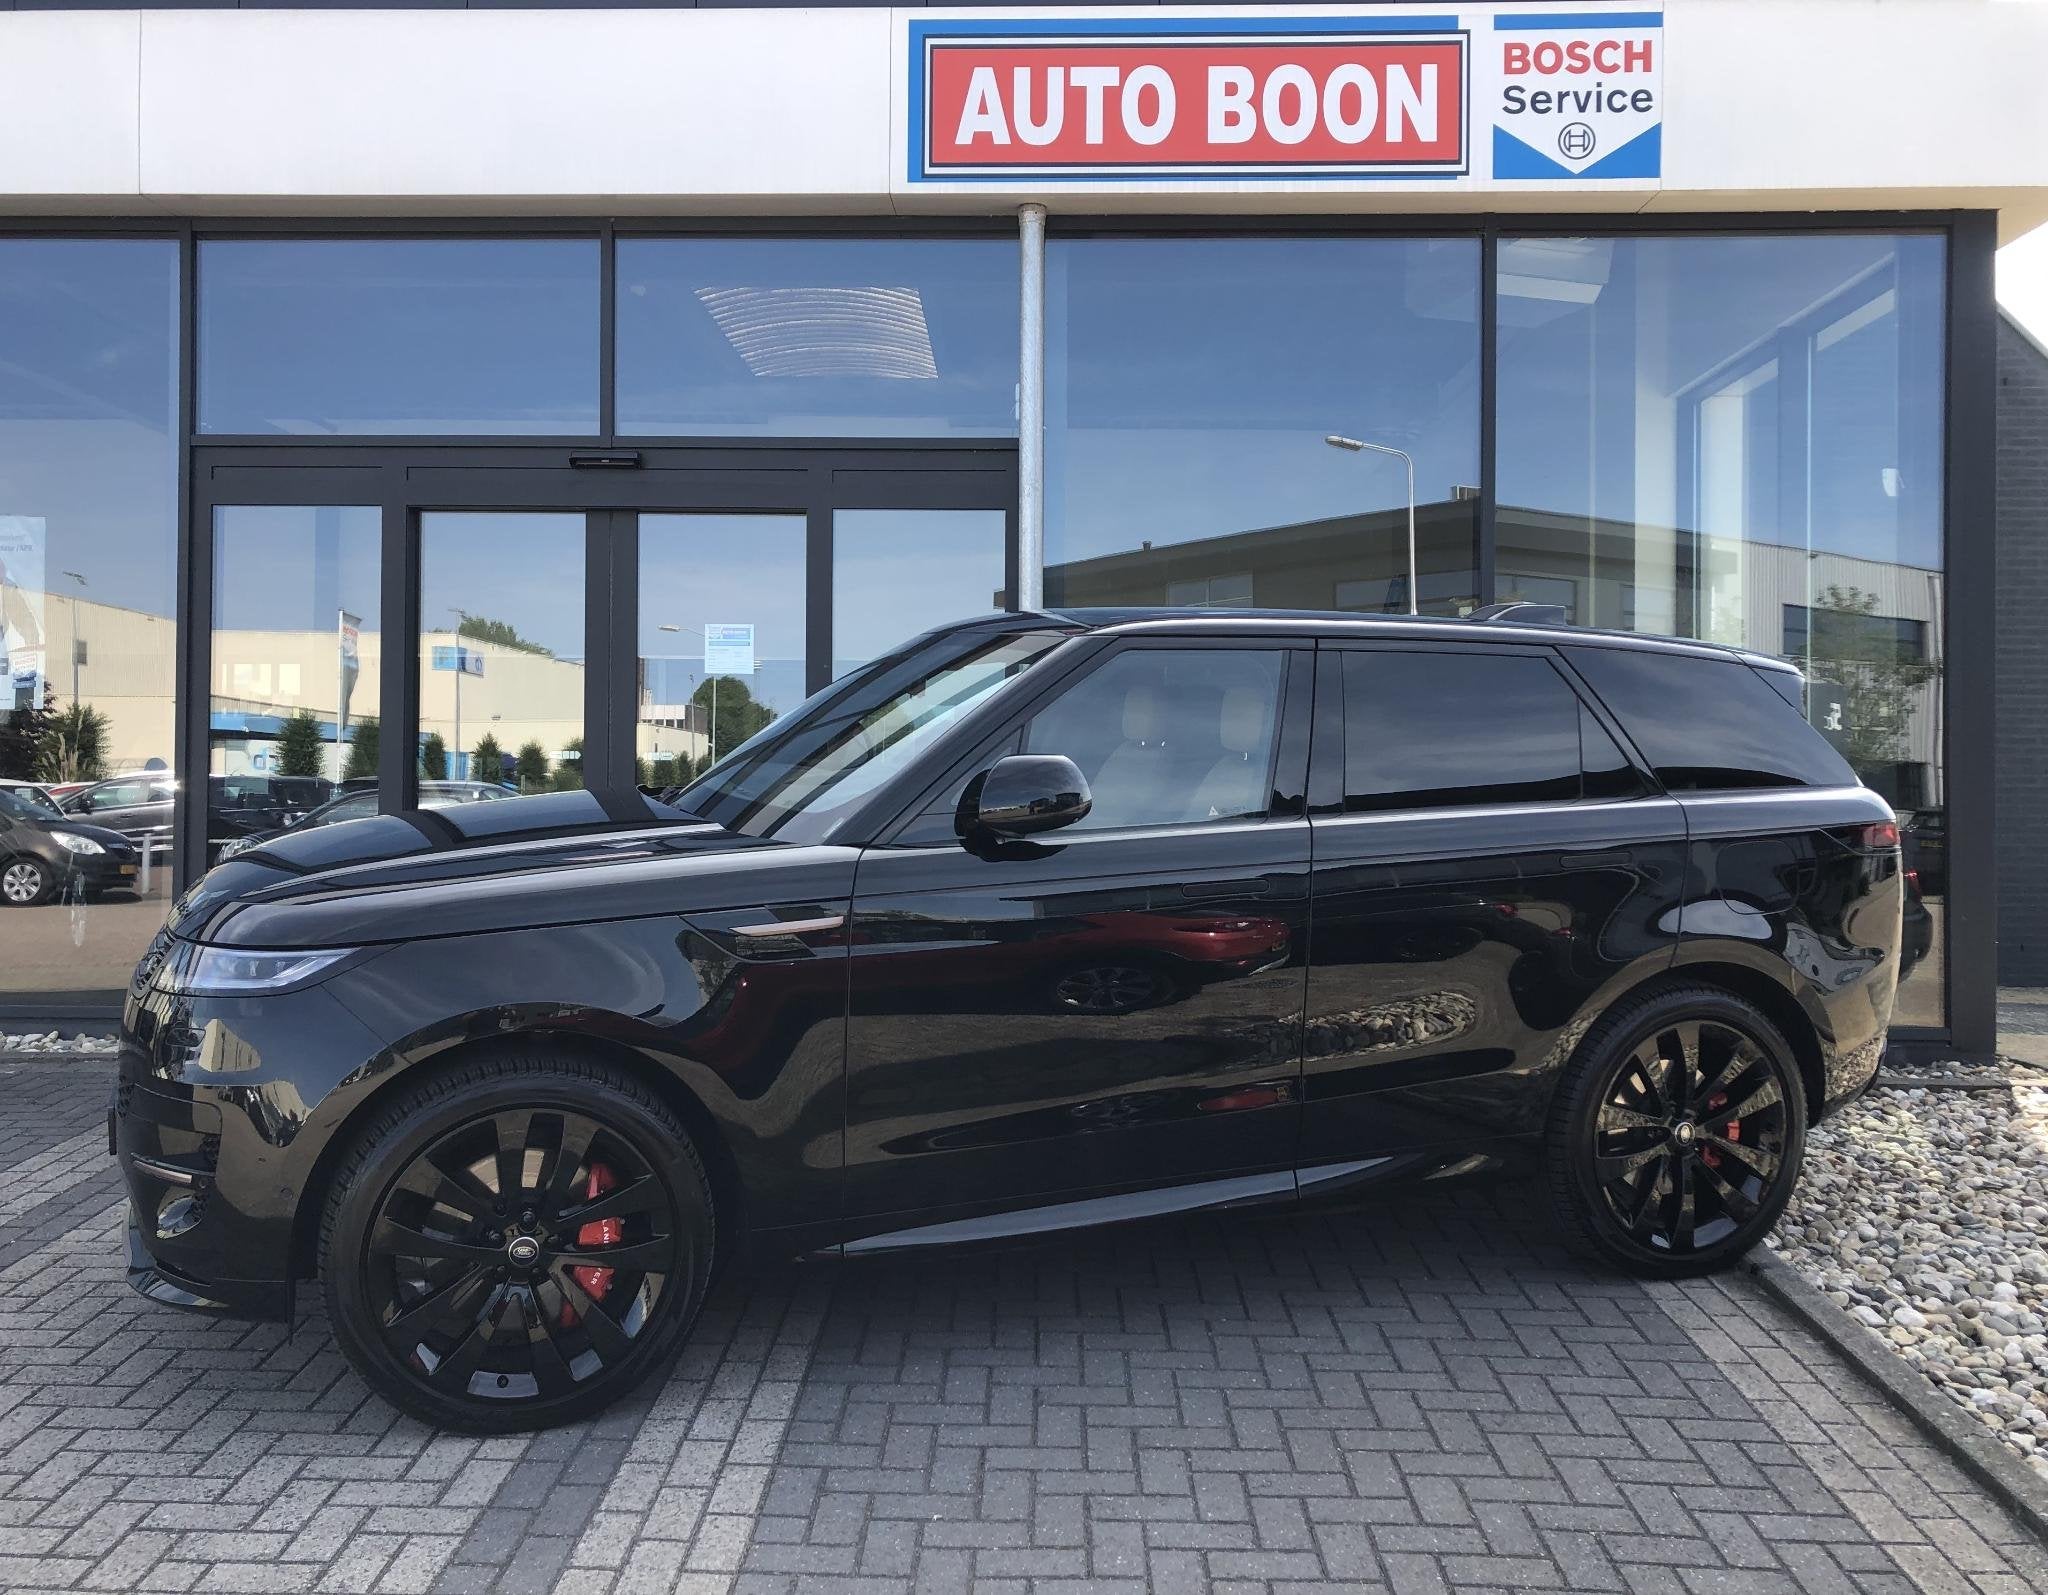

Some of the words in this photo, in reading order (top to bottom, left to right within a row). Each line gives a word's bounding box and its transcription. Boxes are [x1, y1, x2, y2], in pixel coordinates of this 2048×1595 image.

[1503, 40, 1653, 75] BOSCH
[955, 64, 1177, 146] AUTO
[1207, 63, 1438, 145] BOON
[1502, 81, 1653, 115] Service
